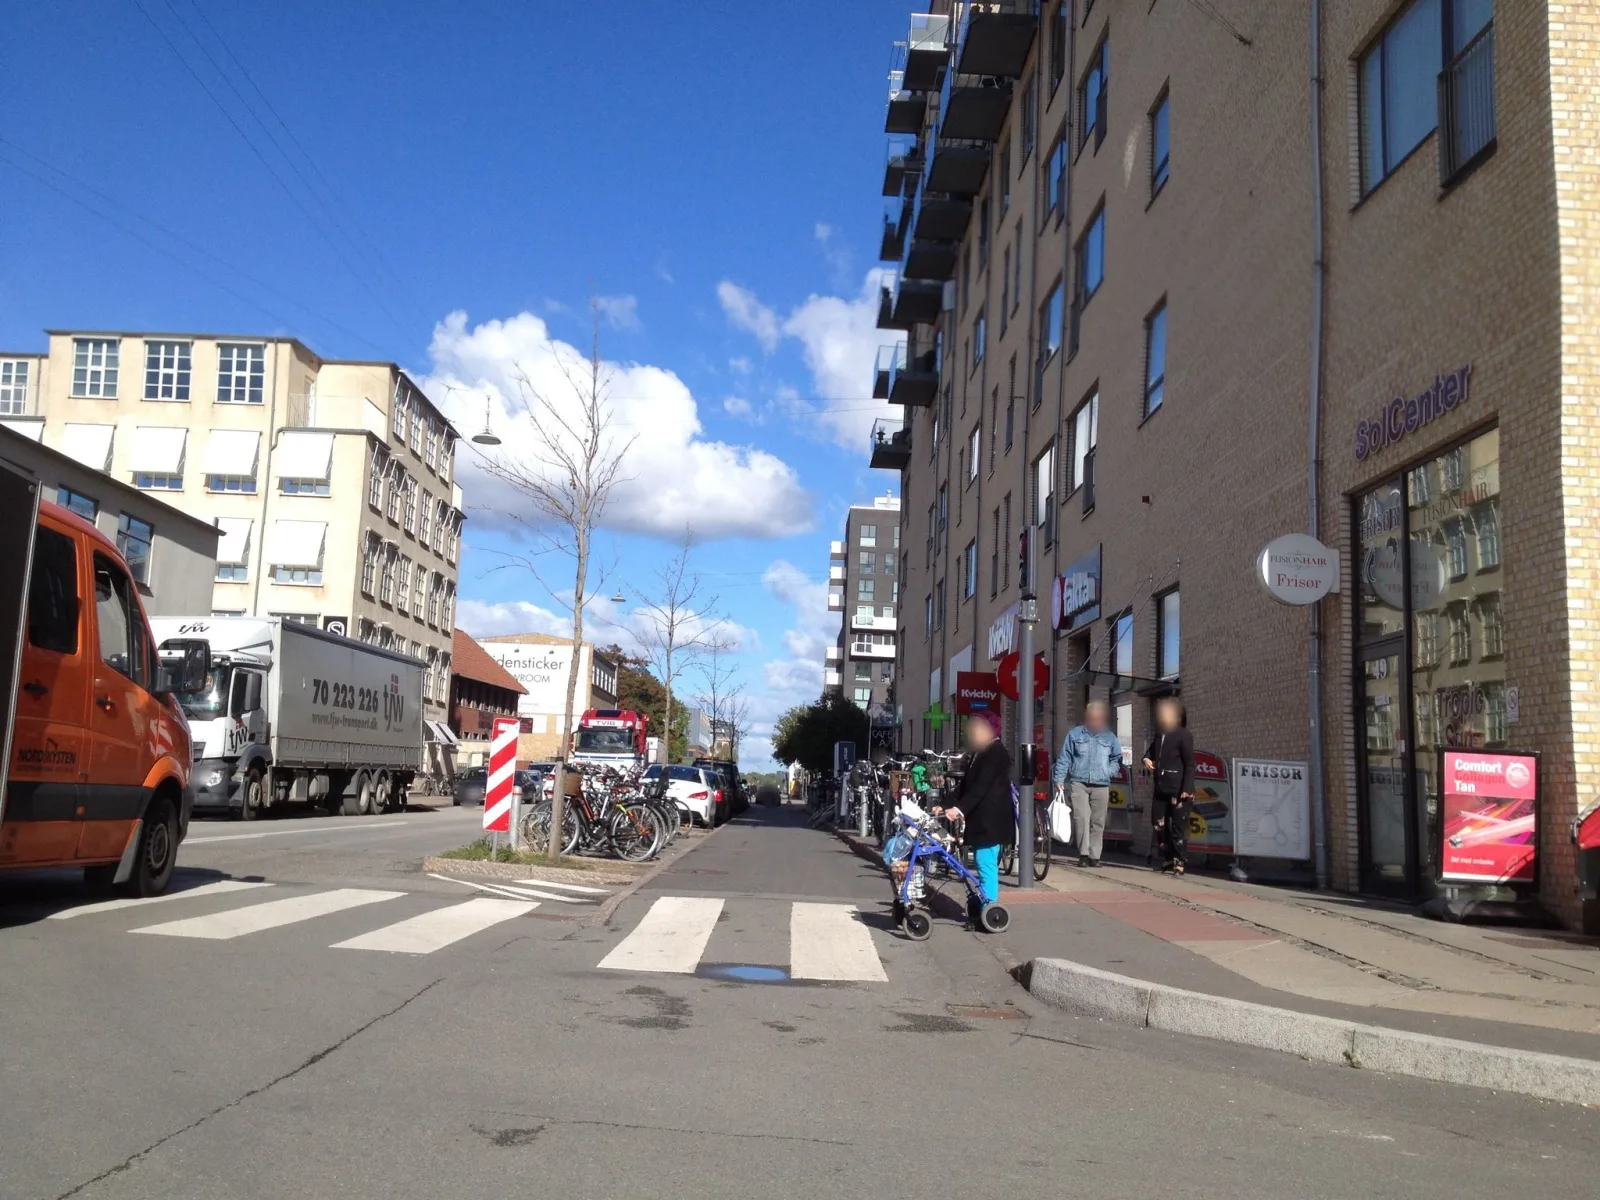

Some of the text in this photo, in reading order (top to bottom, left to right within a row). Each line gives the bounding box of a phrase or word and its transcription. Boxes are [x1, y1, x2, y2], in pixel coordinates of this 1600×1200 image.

[1355, 362, 1472, 461] SolCenter
[1276, 573, 1322, 589] Frisør
[494, 654, 564, 670] densticker
[1373, 658, 1387, 679] 49
[312, 678, 379, 713] 70 223 226
[961, 688, 997, 700] Kvickly
[1436, 684, 1485, 725] Tropic
[1455, 759, 1502, 773] Comfort
[1454, 780, 1476, 793] Tan
